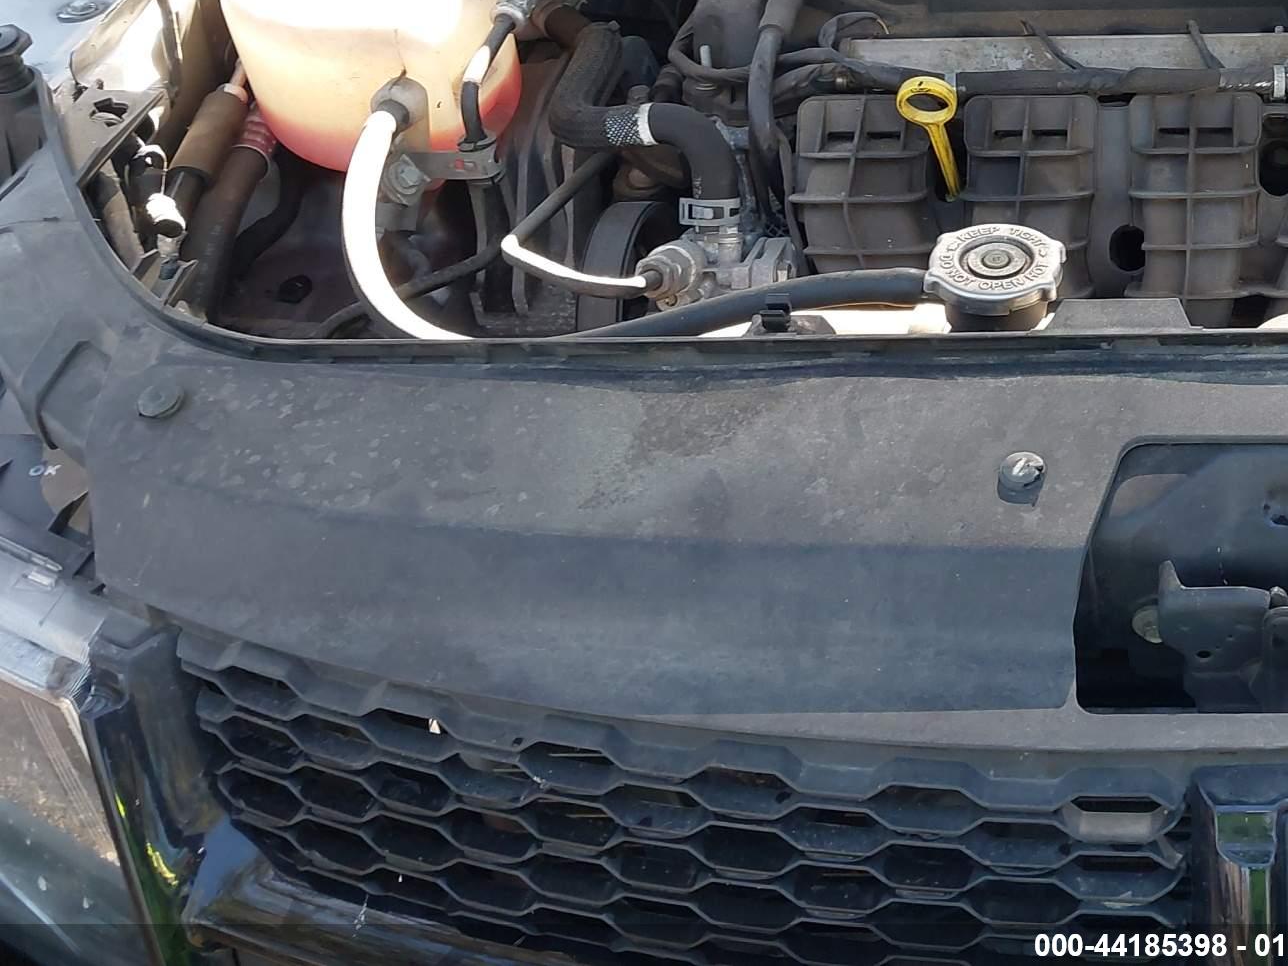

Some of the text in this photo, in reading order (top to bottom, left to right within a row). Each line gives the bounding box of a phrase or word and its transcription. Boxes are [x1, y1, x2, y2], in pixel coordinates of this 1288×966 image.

[958, 227, 1045, 247] KEEP TIGHT
[946, 268, 976, 286] NOT
[978, 277, 1025, 290] OPEN
[1024, 262, 1048, 282] HOT
[29, 464, 62, 476] OK
